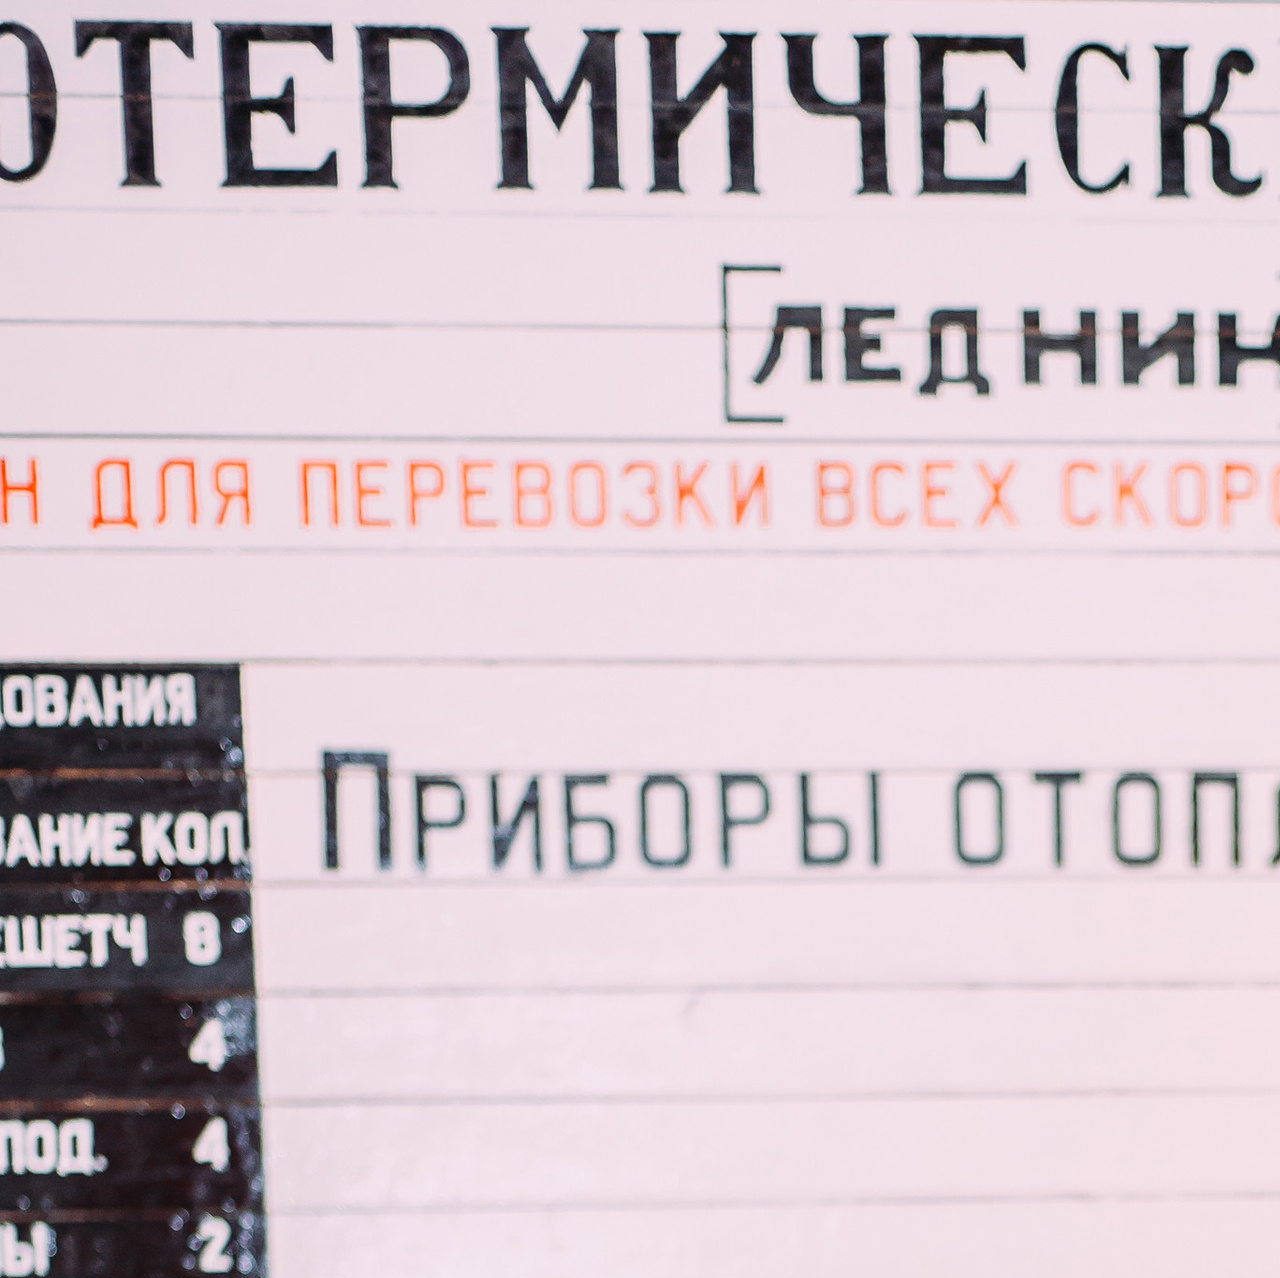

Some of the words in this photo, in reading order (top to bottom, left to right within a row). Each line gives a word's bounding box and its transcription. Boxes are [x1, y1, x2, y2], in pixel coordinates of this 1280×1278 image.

[91, 459, 251, 530] ДЛЯ
[301, 461, 766, 527] ПЕРЕВОЗКИ
[817, 461, 1015, 527] ВСЕХ
[0, 672, 197, 728] ОВАНИЯ
[321, 749, 880, 870] ПРИБОРЫ
[0, 812, 136, 868] АНИЕ
[0, 913, 148, 969] ШЕТЧ
[188, 1017, 229, 1073] 4
[192, 1116, 231, 1173] 4
[199, 1216, 235, 1274] 2
